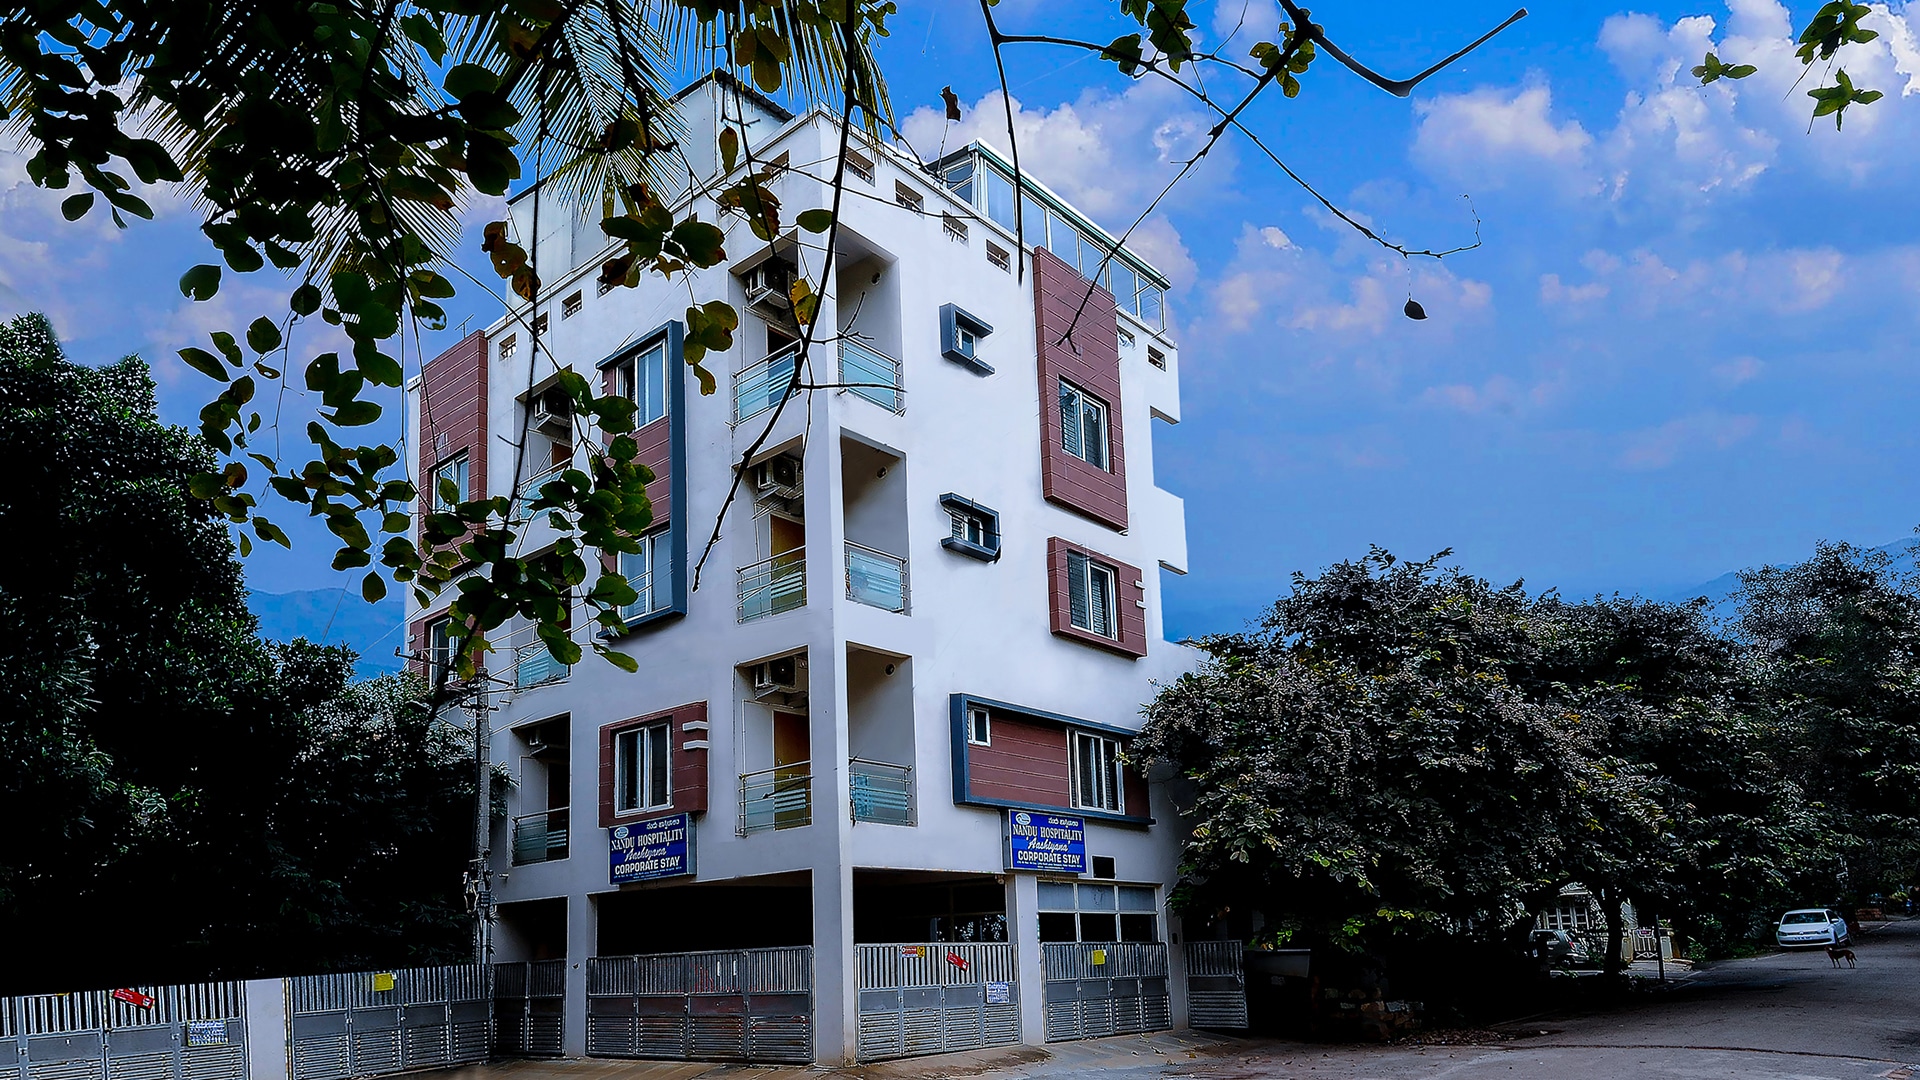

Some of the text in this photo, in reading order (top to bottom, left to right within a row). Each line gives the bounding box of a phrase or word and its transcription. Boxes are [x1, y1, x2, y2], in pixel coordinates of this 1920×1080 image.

[611, 828, 684, 851] NANDU HOSPITALITY
[1013, 824, 1082, 841] NANDU HOSPITALITY
[614, 859, 659, 875] CORPORATE
[660, 856, 681, 869] STAY
[1018, 851, 1061, 863] CORPORATE
[1063, 854, 1081, 864] STAY
